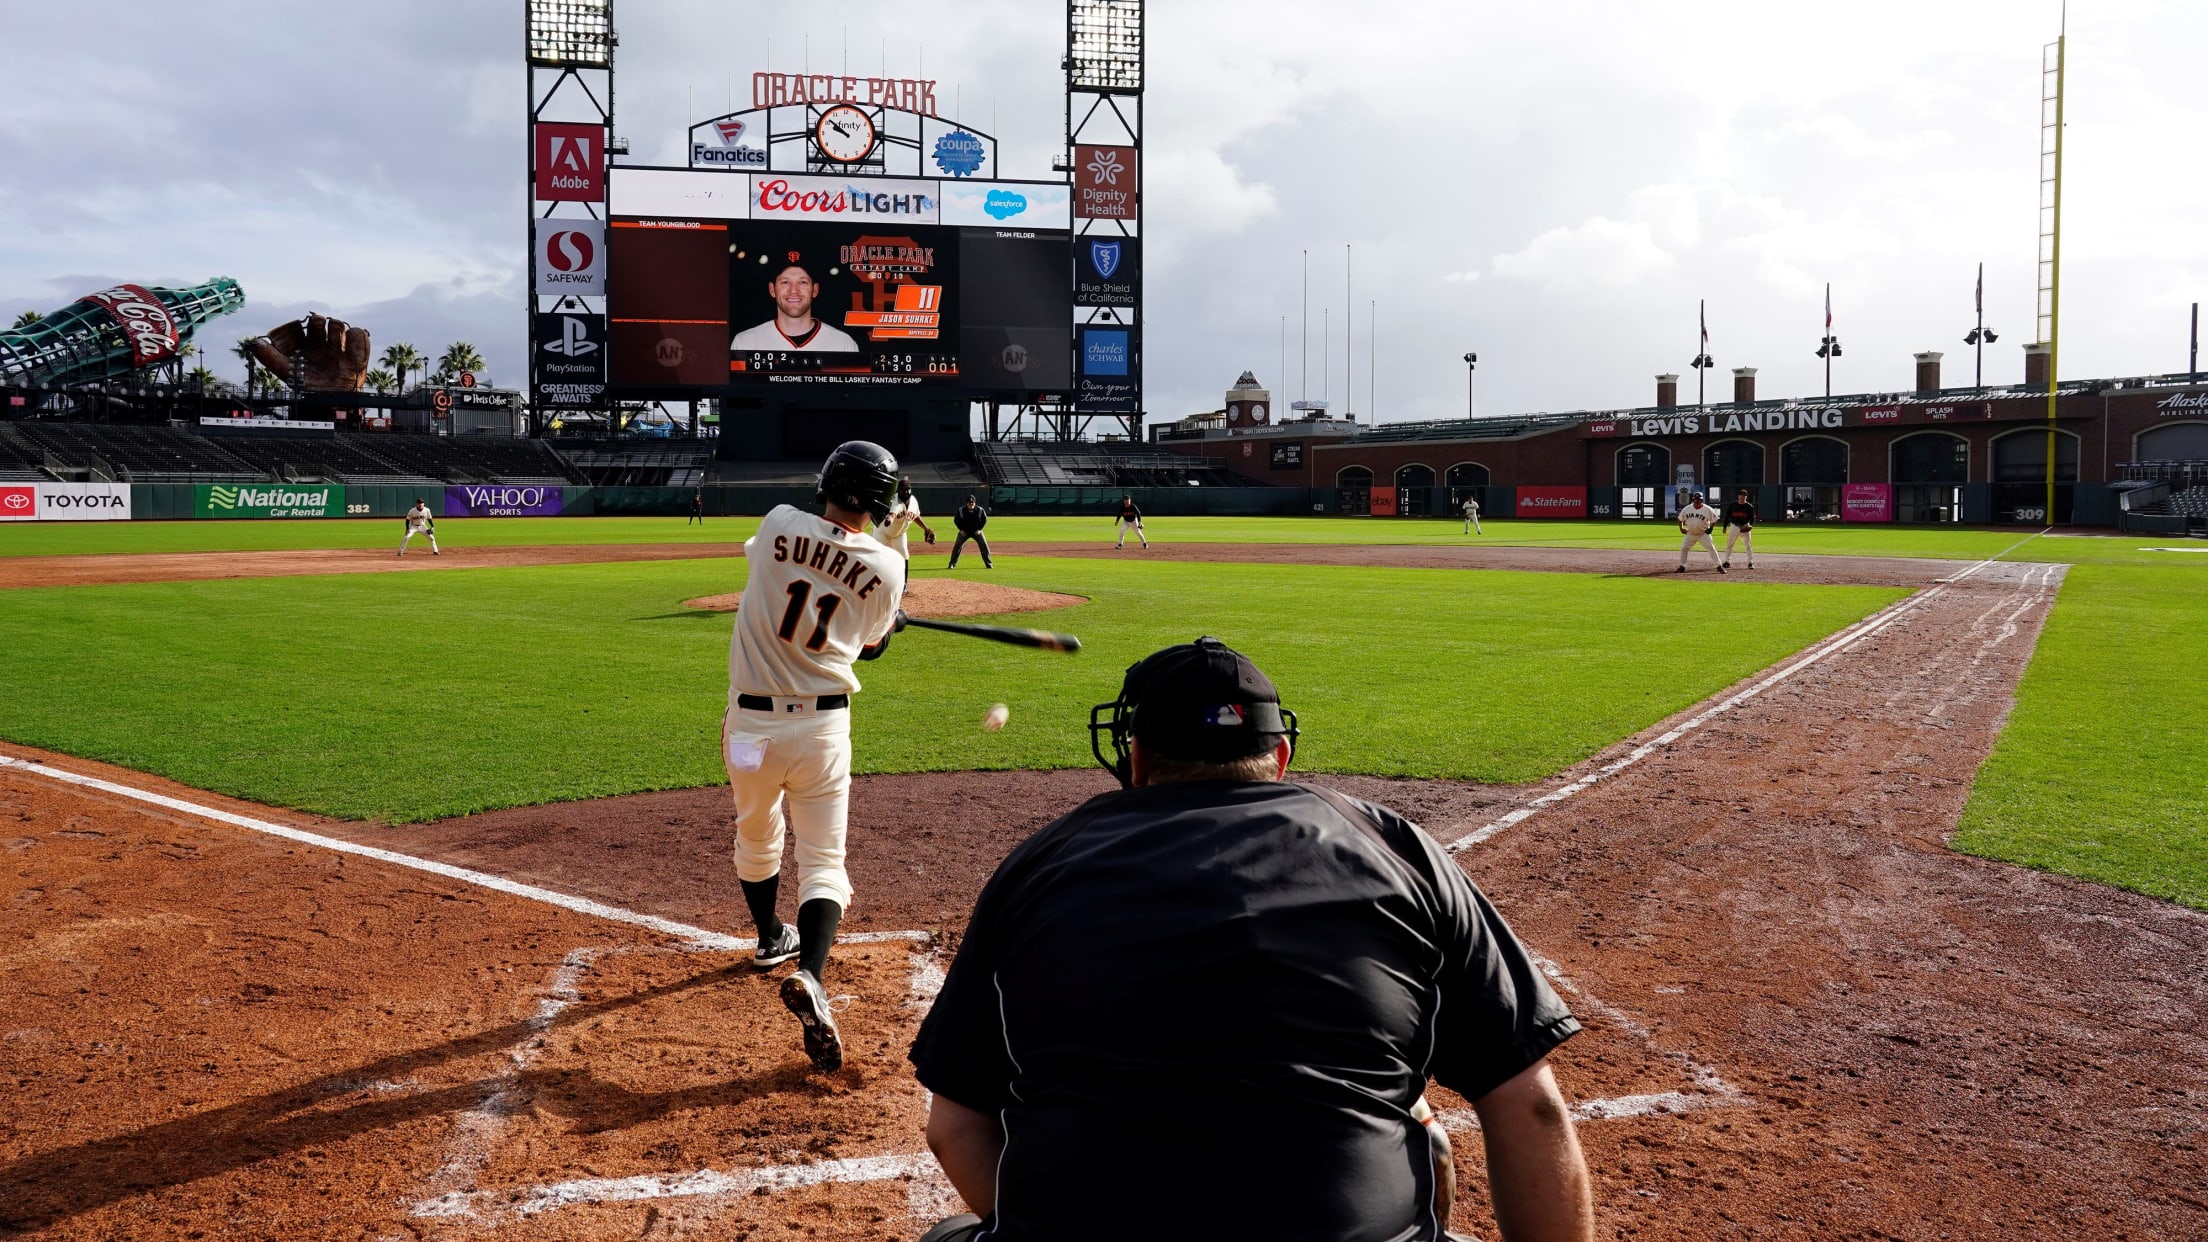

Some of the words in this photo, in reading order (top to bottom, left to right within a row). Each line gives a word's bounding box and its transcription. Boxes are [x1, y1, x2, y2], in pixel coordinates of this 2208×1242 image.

[753, 72, 857, 110] ORACLE
[867, 78, 938, 119] PARK
[940, 139, 981, 154] coupa
[694, 144, 766, 163] Fanatics
[551, 175, 590, 189] Adobe
[758, 179, 848, 213] Coors
[851, 192, 926, 214] LIGHT
[1083, 188, 1127, 204] Dignity
[990, 199, 1024, 209] salesforce
[1085, 203, 1126, 216] Health
[658, 221, 701, 229] YOUNGBLOOD
[1013, 231, 1035, 239] FELDER
[840, 245, 894, 264] ORACLE
[898, 247, 934, 267] PARK
[546, 273, 594, 284] SAFEWAY
[1081, 283, 1100, 292] Blue
[1103, 284, 1130, 293] Shield
[918, 287, 935, 309] 11
[1078, 293, 1088, 302] of
[1089, 293, 1134, 303] California
[878, 314, 903, 323] JASON
[905, 315, 934, 324] SUHRKE
[1088, 342, 1124, 354] charles
[1088, 354, 1124, 362] SCHWAB
[546, 363, 595, 374] PlayStation
[769, 375, 803, 383] WELCOME
[540, 383, 601, 394] GREATNESS
[1081, 379, 1103, 391] Own
[1104, 385, 1132, 395] your
[489, 395, 507, 406] Coffee
[551, 393, 592, 403] AWAITS
[1080, 393, 1133, 402] tomorrow
[1925, 406, 1953, 415] SPLASH
[1709, 408, 1843, 433] LANDING
[43, 495, 125, 508] TOYOTA
[237, 488, 328, 507] National
[465, 487, 544, 507] YAHOO!
[1371, 497, 1392, 508] ebay
[270, 508, 283, 517] Car
[284, 508, 325, 517] Rental
[347, 504, 370, 514] 382
[489, 508, 521, 516] SPORTS
[1593, 504, 1610, 514] 365
[2015, 508, 2045, 520] 309
[773, 535, 883, 601] SUHRKE
[778, 579, 842, 652] 11
